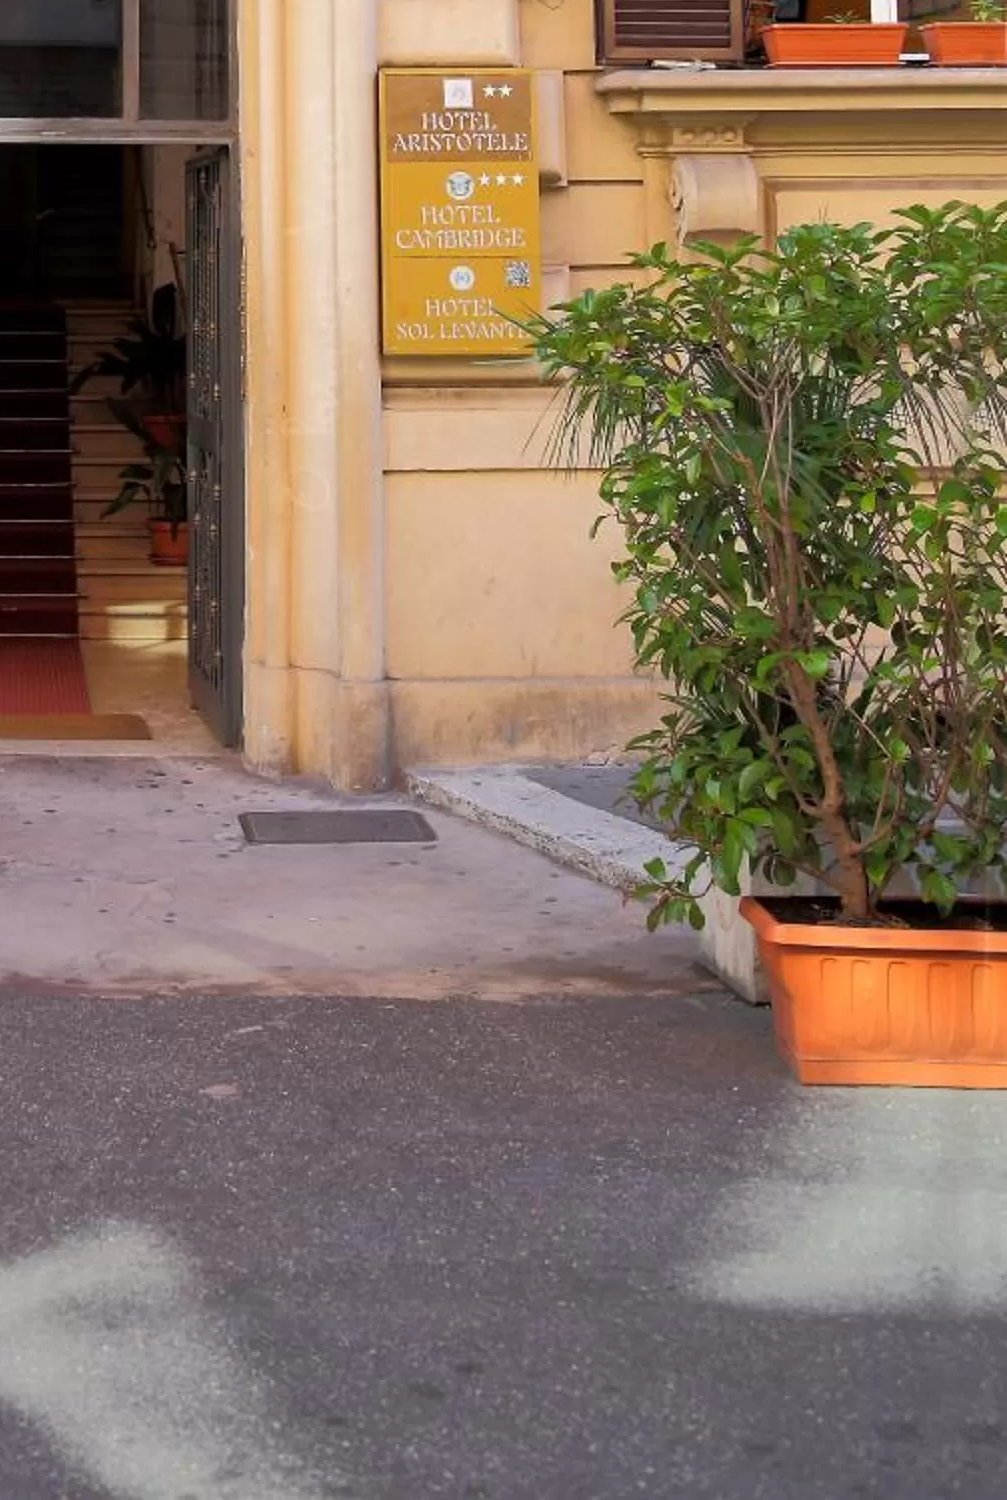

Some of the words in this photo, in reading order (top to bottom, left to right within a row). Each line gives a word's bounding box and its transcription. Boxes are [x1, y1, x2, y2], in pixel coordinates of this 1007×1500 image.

[422, 112, 498, 131] HOTEL
[393, 133, 528, 152] ARISTOTELE
[421, 205, 501, 225] HOTEL
[396, 228, 526, 250] CAMBRIDGE
[425, 298, 500, 317] HOTEL
[397, 324, 435, 341] SOL
[440, 322, 530, 341] LEVANTE
